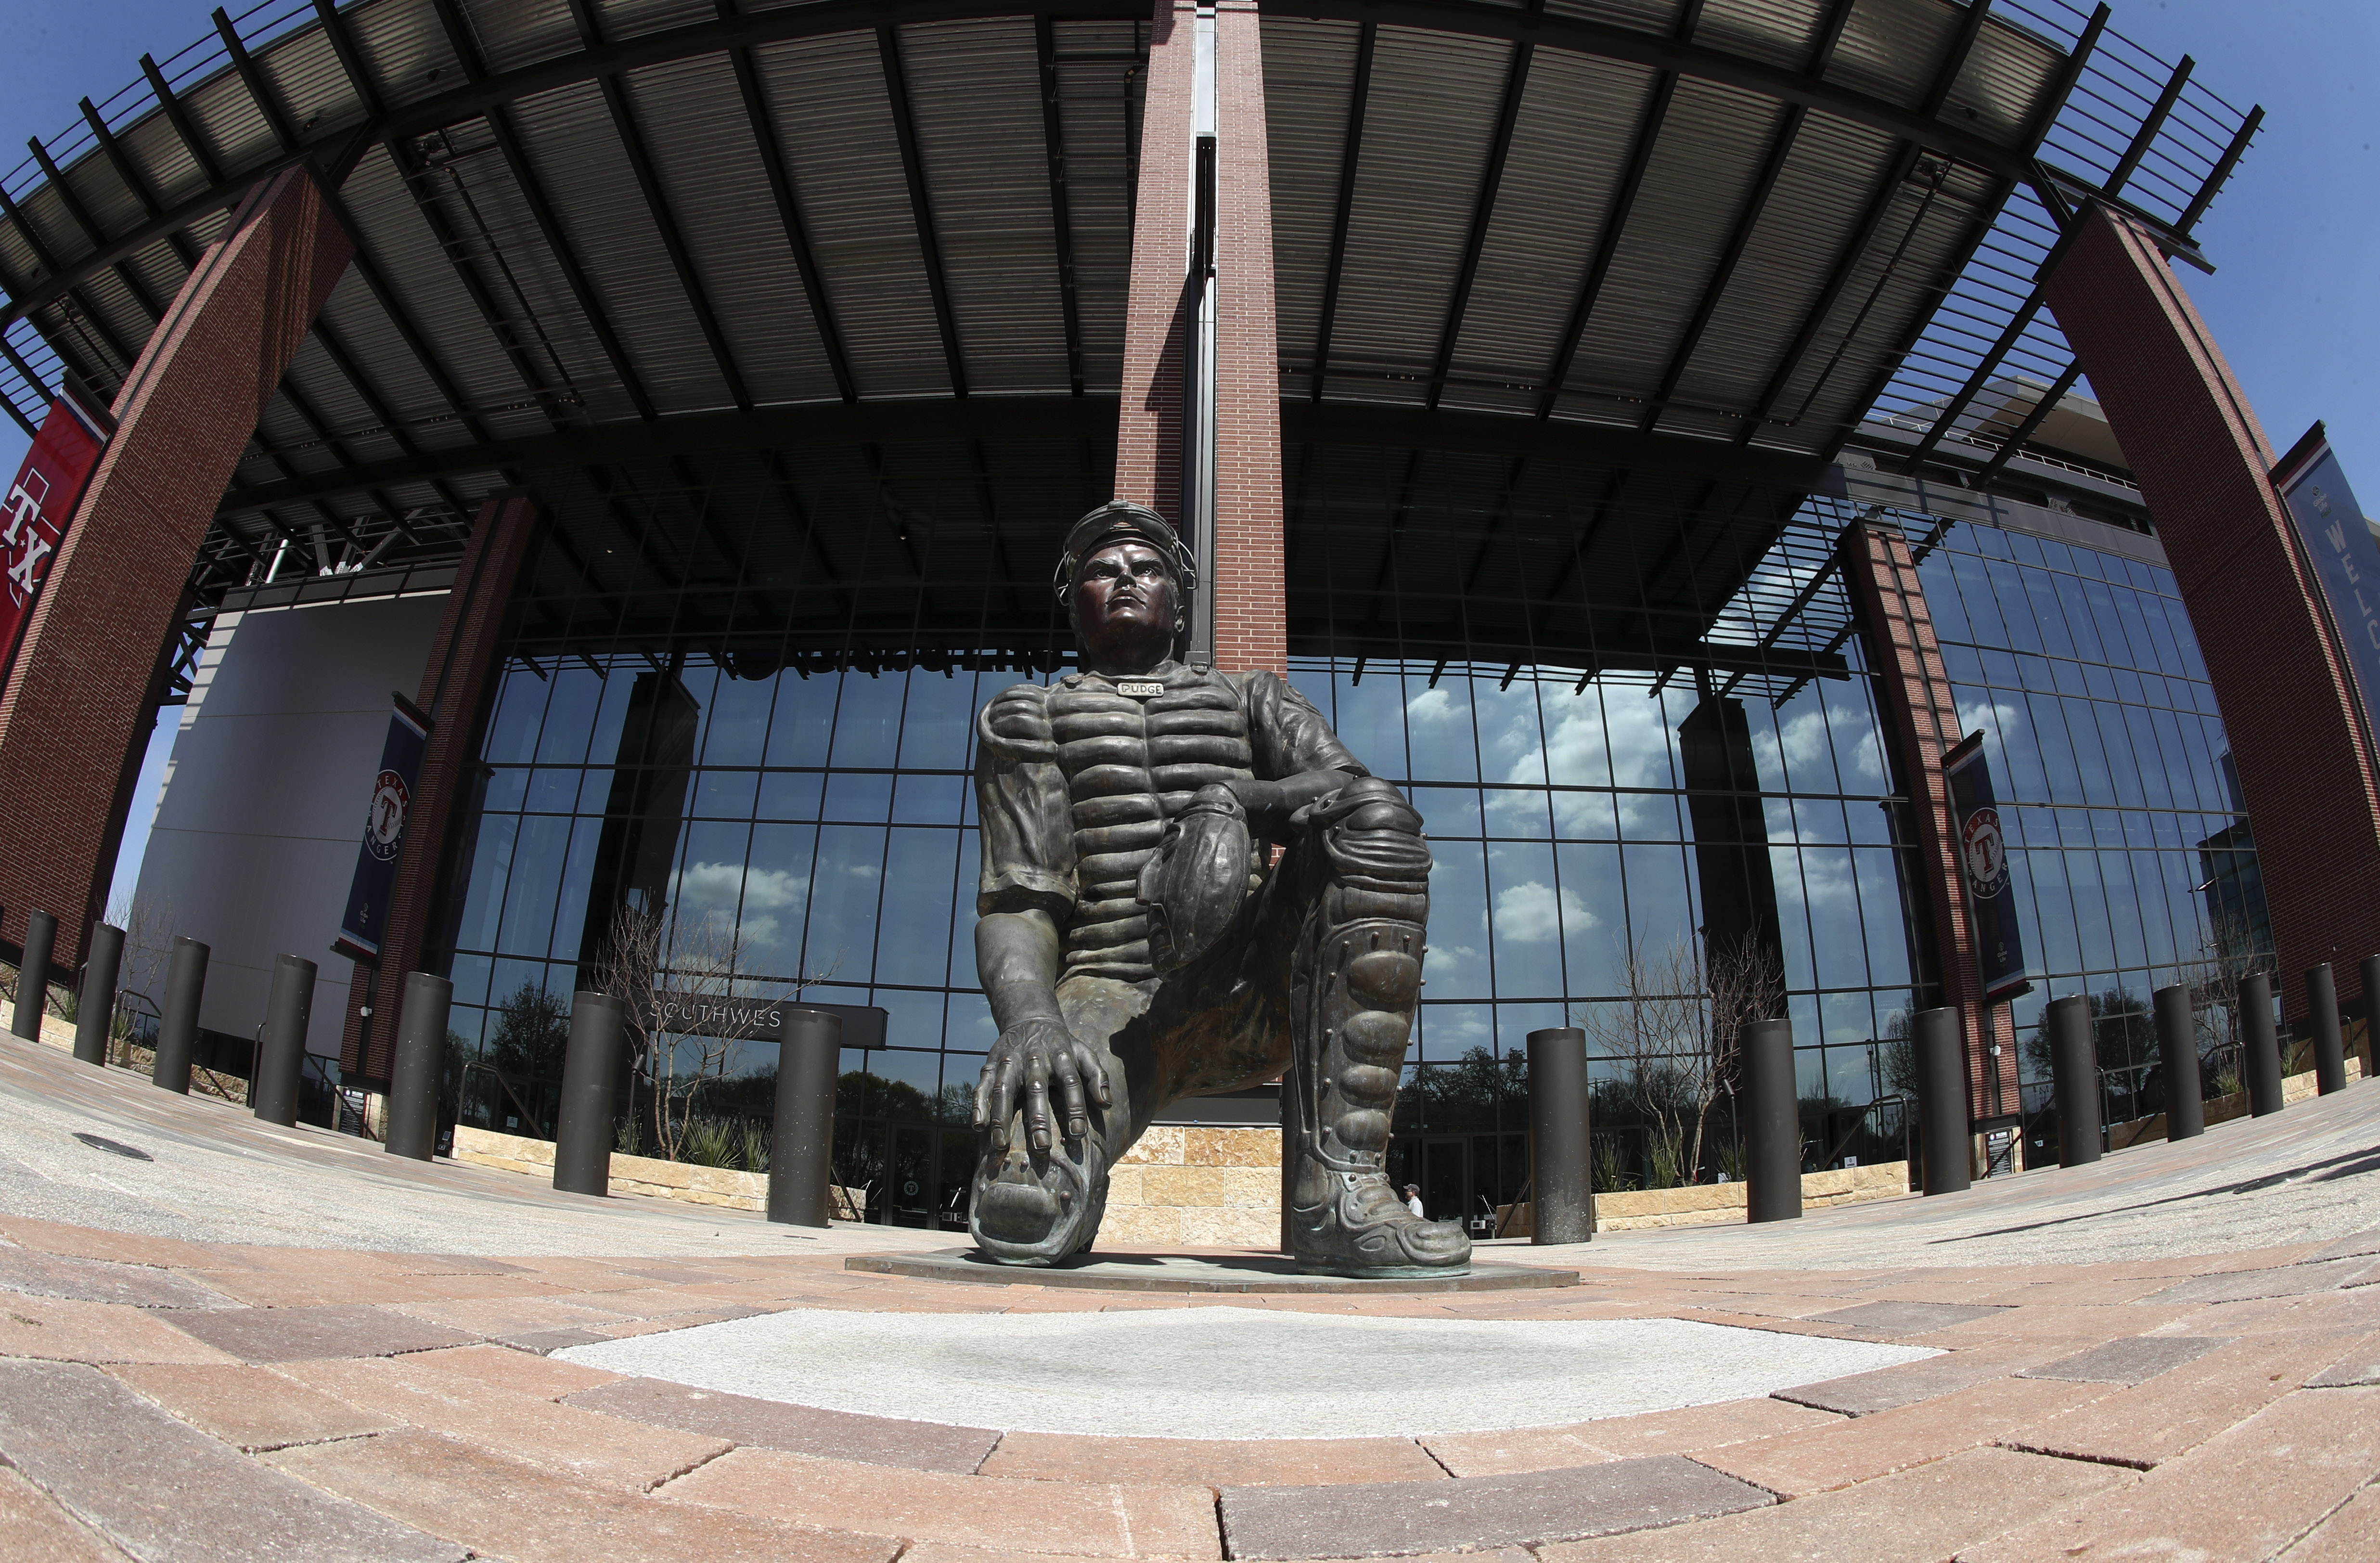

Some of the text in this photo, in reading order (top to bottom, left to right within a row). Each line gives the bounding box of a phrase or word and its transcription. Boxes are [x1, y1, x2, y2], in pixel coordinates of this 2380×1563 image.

[2325, 519, 2380, 666] WELC
[1121, 684, 1163, 694] PUDGE
[377, 775, 408, 807] TEXAS
[380, 794, 398, 837] T
[1965, 814, 1998, 843] TEXAS
[1974, 832, 1995, 874] T
